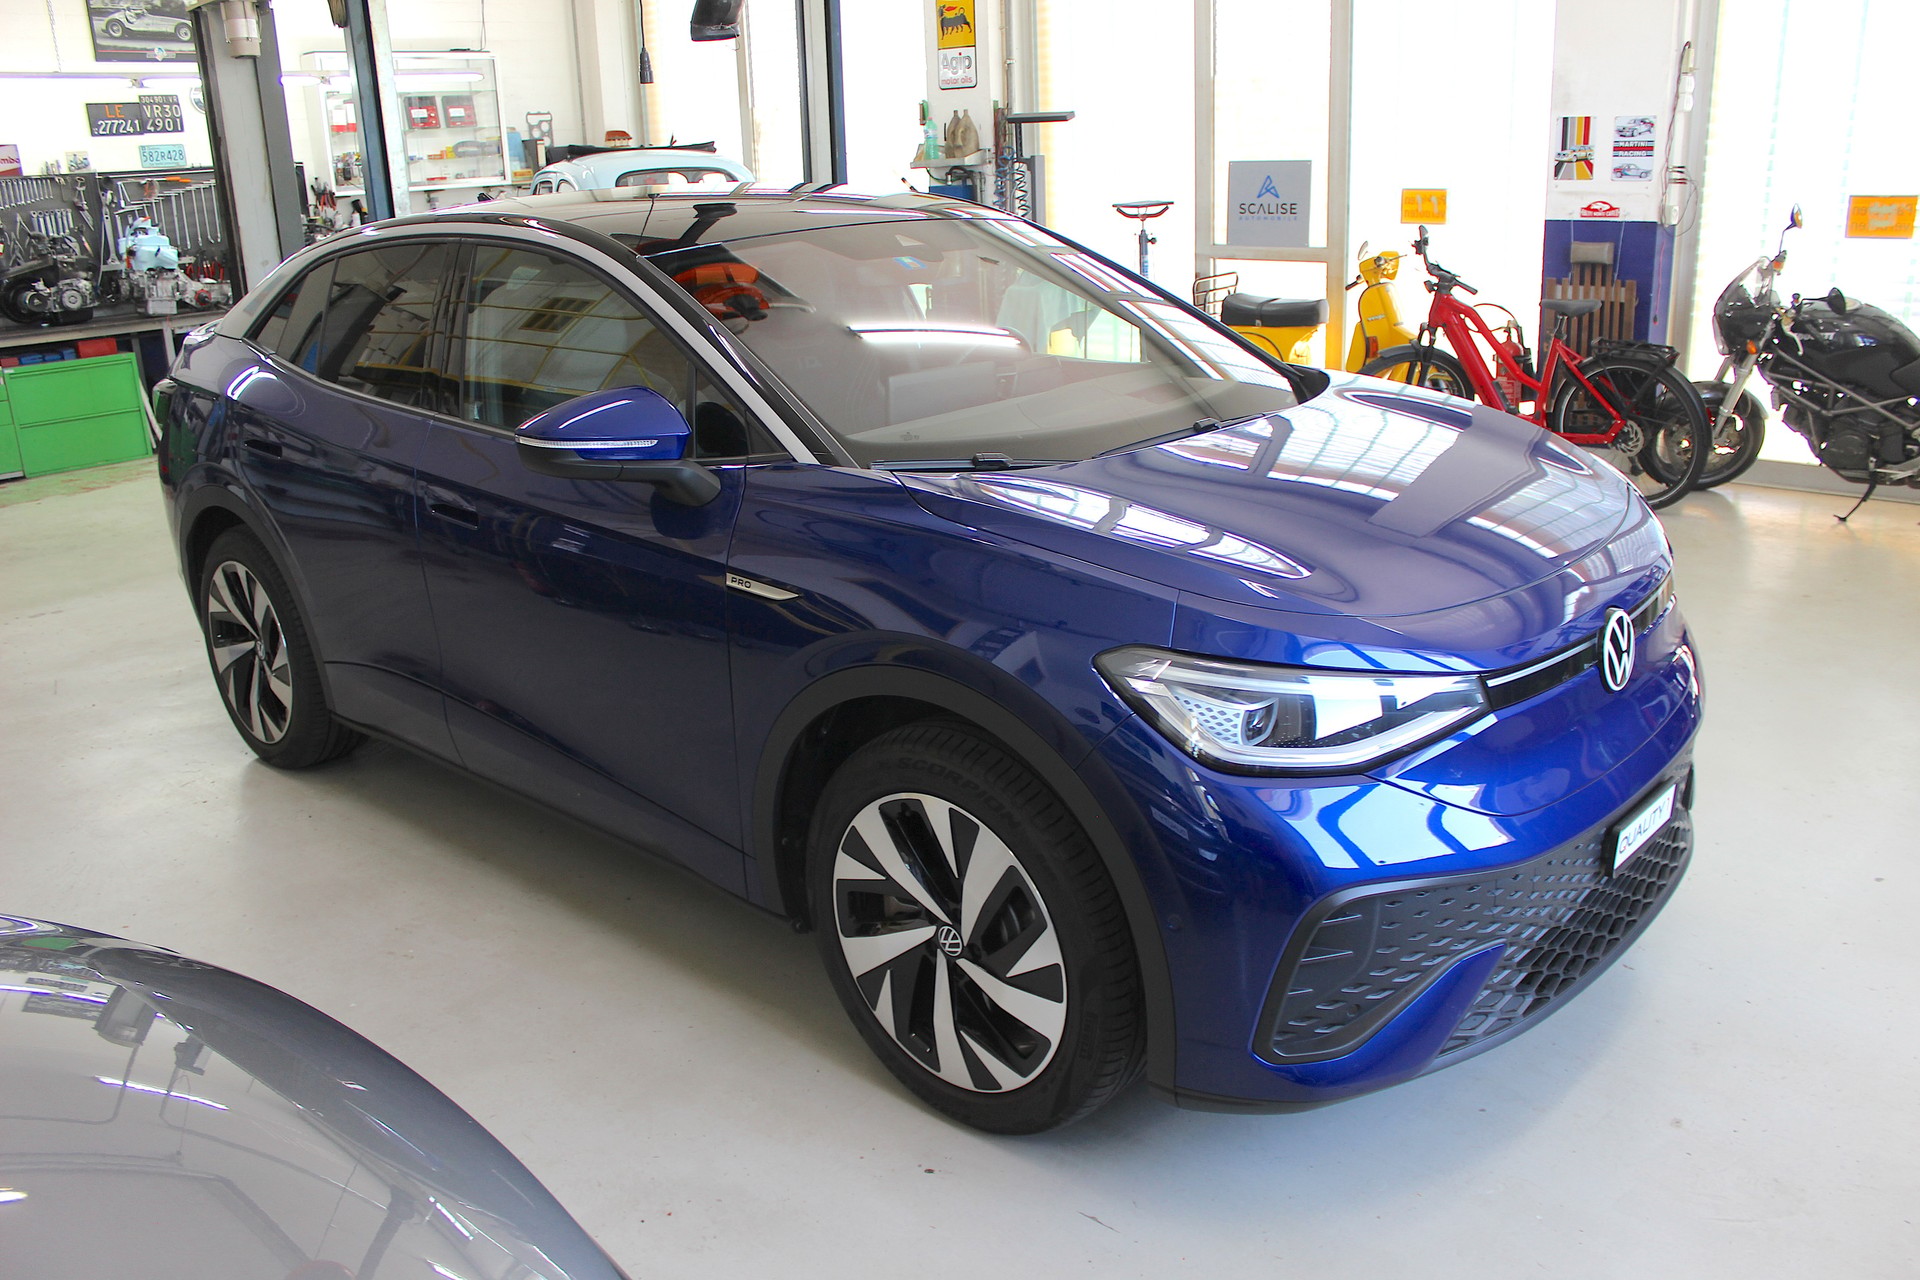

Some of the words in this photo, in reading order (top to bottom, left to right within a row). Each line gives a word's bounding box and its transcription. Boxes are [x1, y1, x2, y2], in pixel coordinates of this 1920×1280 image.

[942, 52, 972, 75] Agip
[104, 104, 125, 118] LE
[98, 119, 140, 135] 277241
[147, 118, 182, 132] 4901
[142, 149, 185, 163] 582R428
[1239, 203, 1298, 215] SCALISE
[730, 576, 752, 589] PRO
